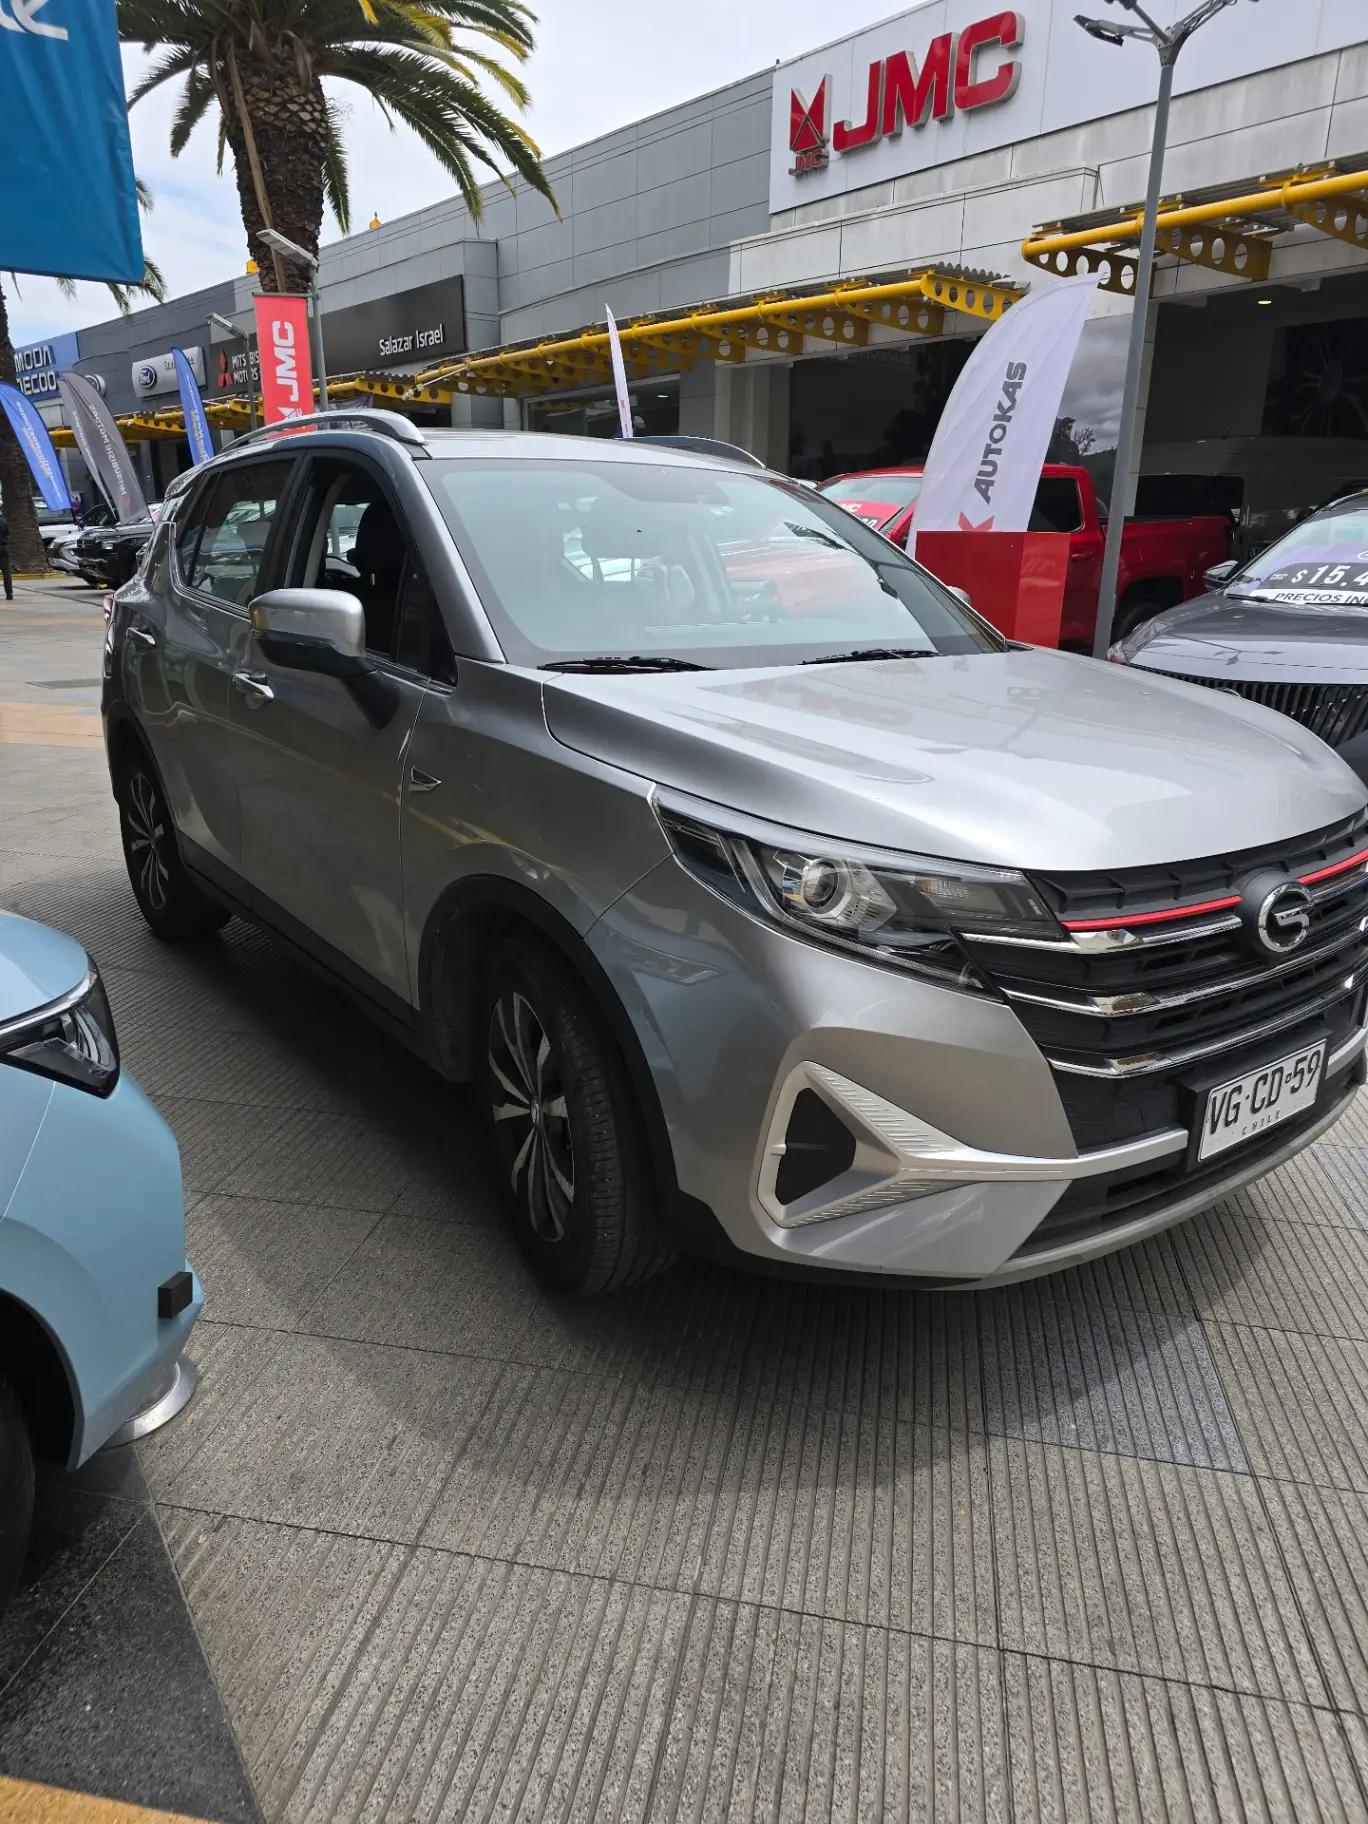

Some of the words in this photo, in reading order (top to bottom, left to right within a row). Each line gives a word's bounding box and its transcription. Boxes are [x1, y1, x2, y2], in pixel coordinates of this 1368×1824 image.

[833, 10, 1022, 152] JMC
[788, 148, 829, 177] JMC
[379, 335, 413, 356] Salazar
[416, 323, 444, 349] Israel
[14, 344, 52, 373] MODA
[272, 320, 299, 402] JMC
[974, 361, 1027, 505] AUTOKAS
[1274, 593, 1342, 603] PRECIOS
[1242, 1110, 1280, 1135] CHILE
